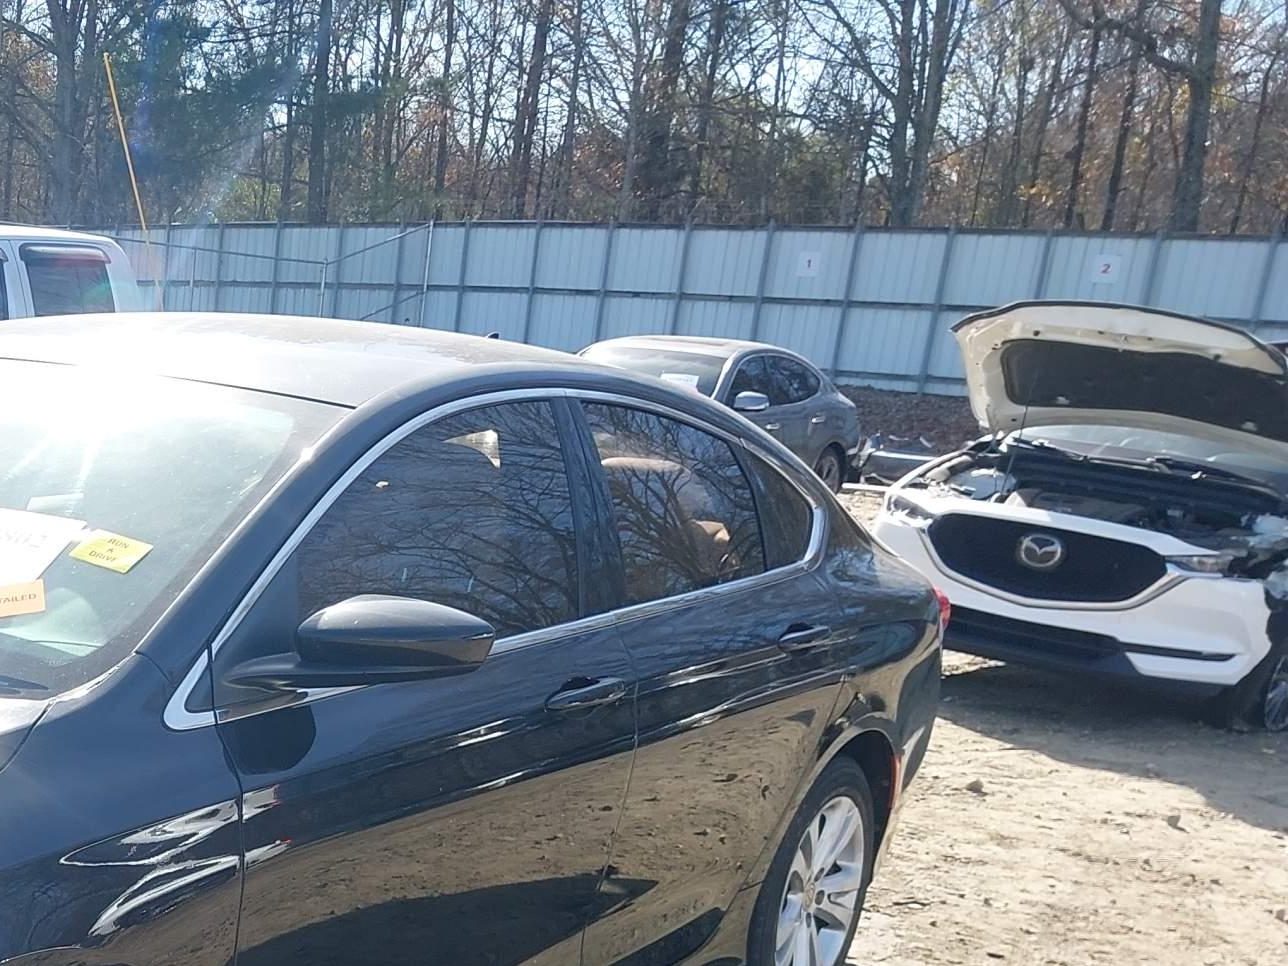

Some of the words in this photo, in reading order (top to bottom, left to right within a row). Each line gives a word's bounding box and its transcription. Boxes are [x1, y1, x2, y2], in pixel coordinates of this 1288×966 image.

[1101, 263, 1112, 274] 2
[107, 538, 130, 549] RUN
[88, 550, 118, 562] DRIVE
